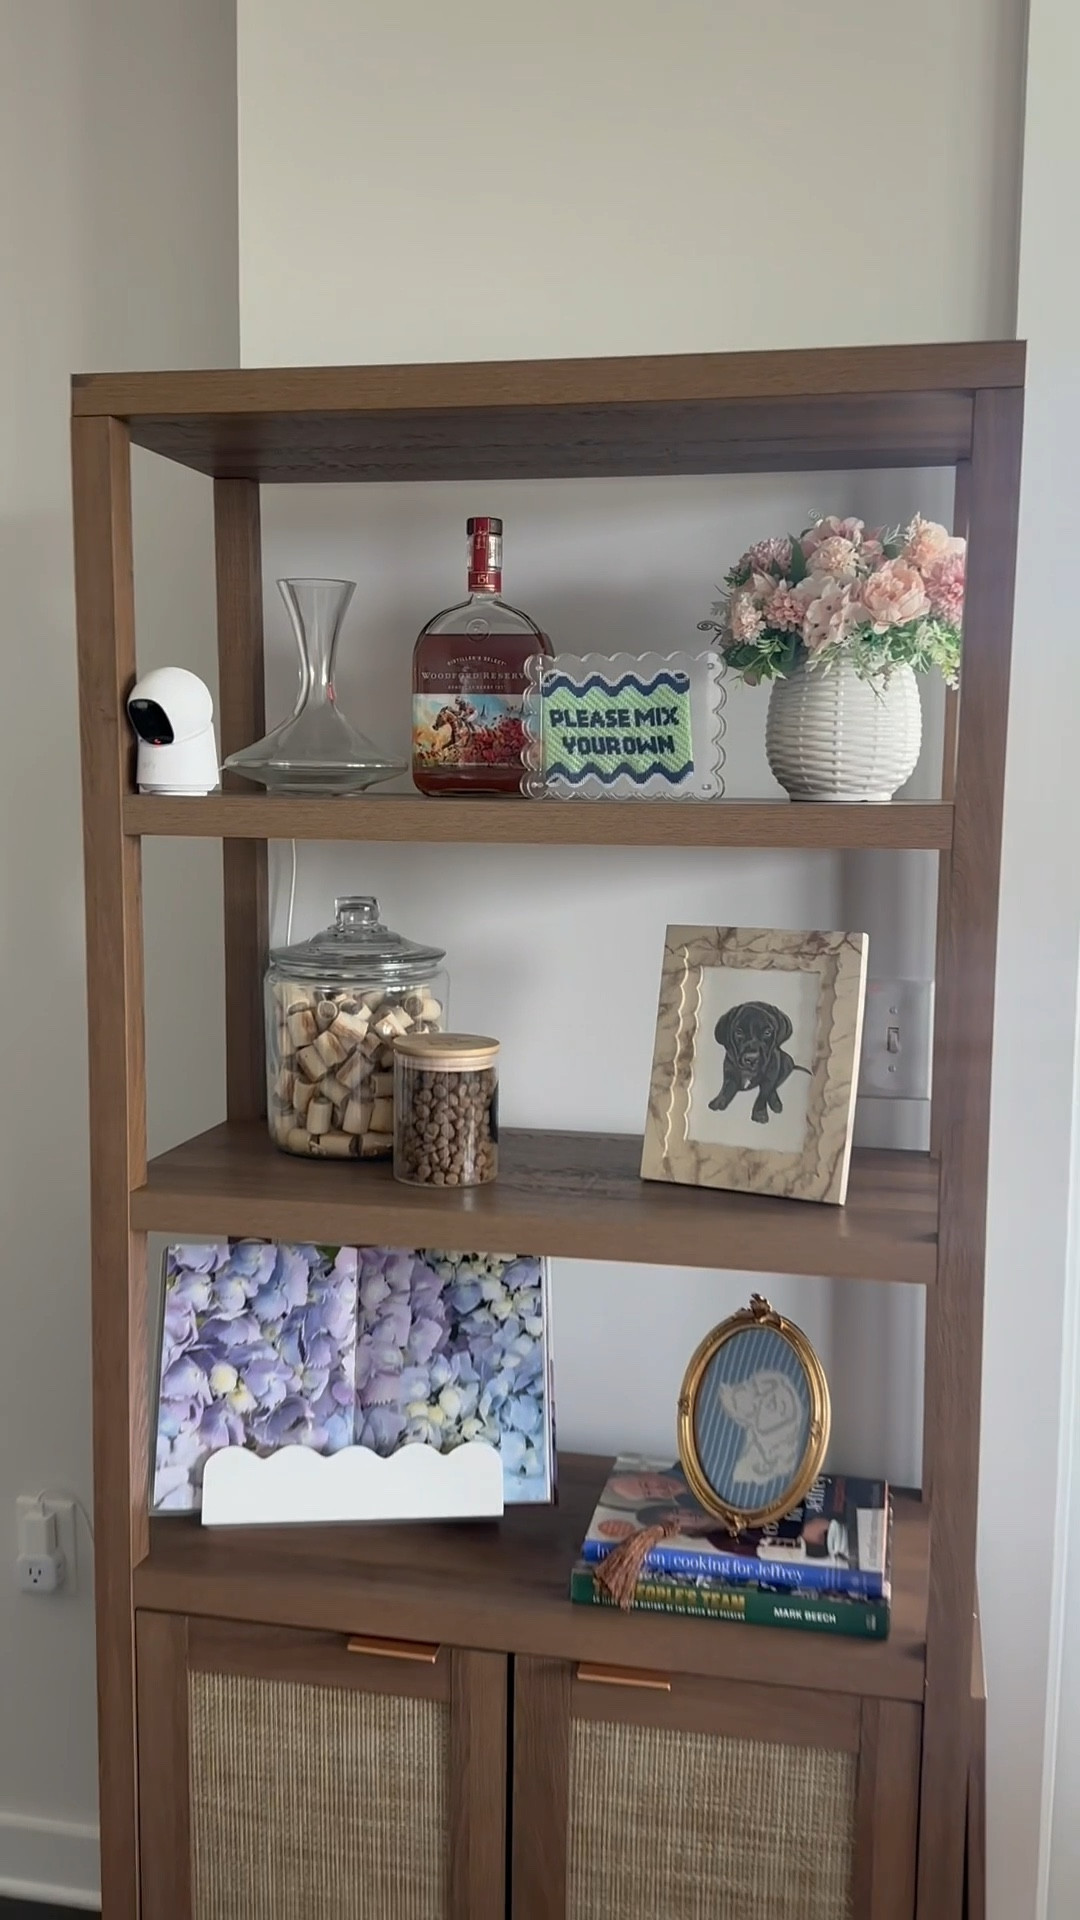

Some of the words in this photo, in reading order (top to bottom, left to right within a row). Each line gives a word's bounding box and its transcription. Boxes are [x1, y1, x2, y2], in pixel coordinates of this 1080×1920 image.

[421, 671, 480, 680] WOODFORD
[549, 708, 631, 728] PLEASE
[633, 706, 680, 728] MIX
[562, 736, 621, 755] YOUR
[622, 735, 676, 754] OWN
[673, 1555, 730, 1575] cooking
[732, 1558, 754, 1575] for
[755, 1561, 804, 1583] Jeffrey
[700, 1590, 746, 1612] TEAM
[773, 1606, 803, 1621] MARK
[804, 1609, 837, 1625] BEECH
